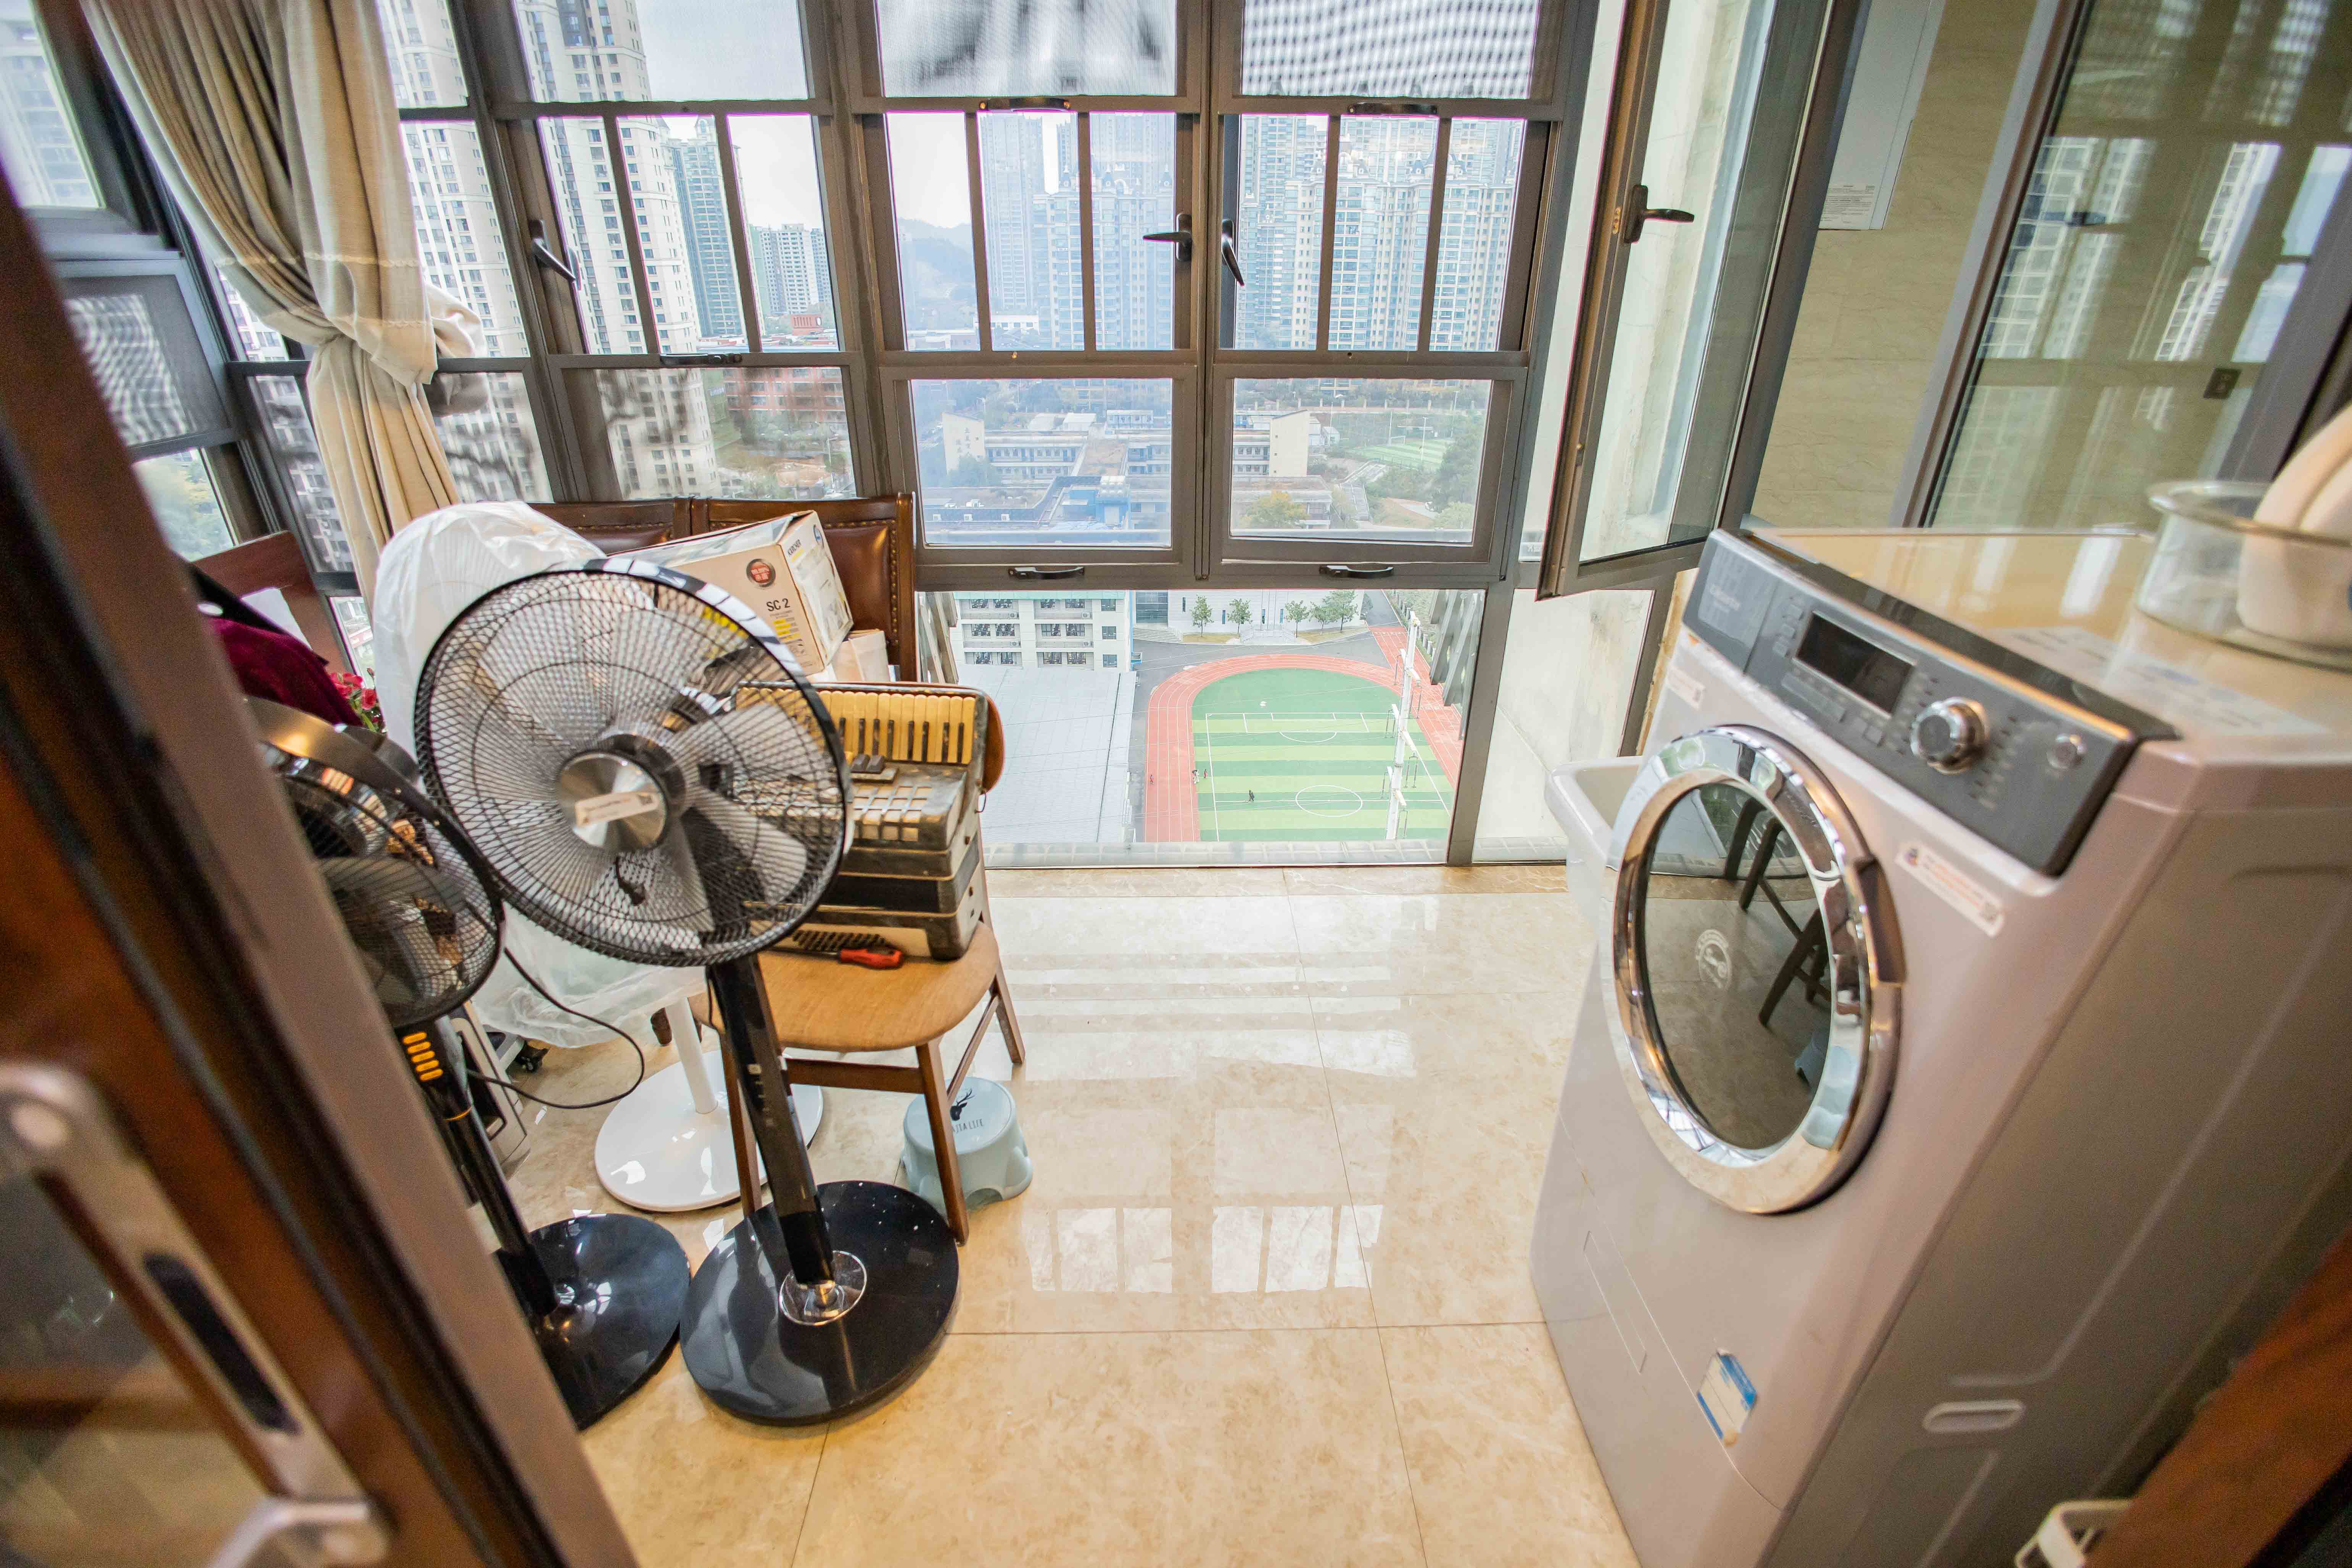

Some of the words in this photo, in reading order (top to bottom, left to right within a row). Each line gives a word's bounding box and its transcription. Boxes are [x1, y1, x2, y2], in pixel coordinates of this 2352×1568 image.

[766, 600, 781, 611] SC
[782, 598, 790, 608] 2
[969, 1119, 984, 1129] LIFE
